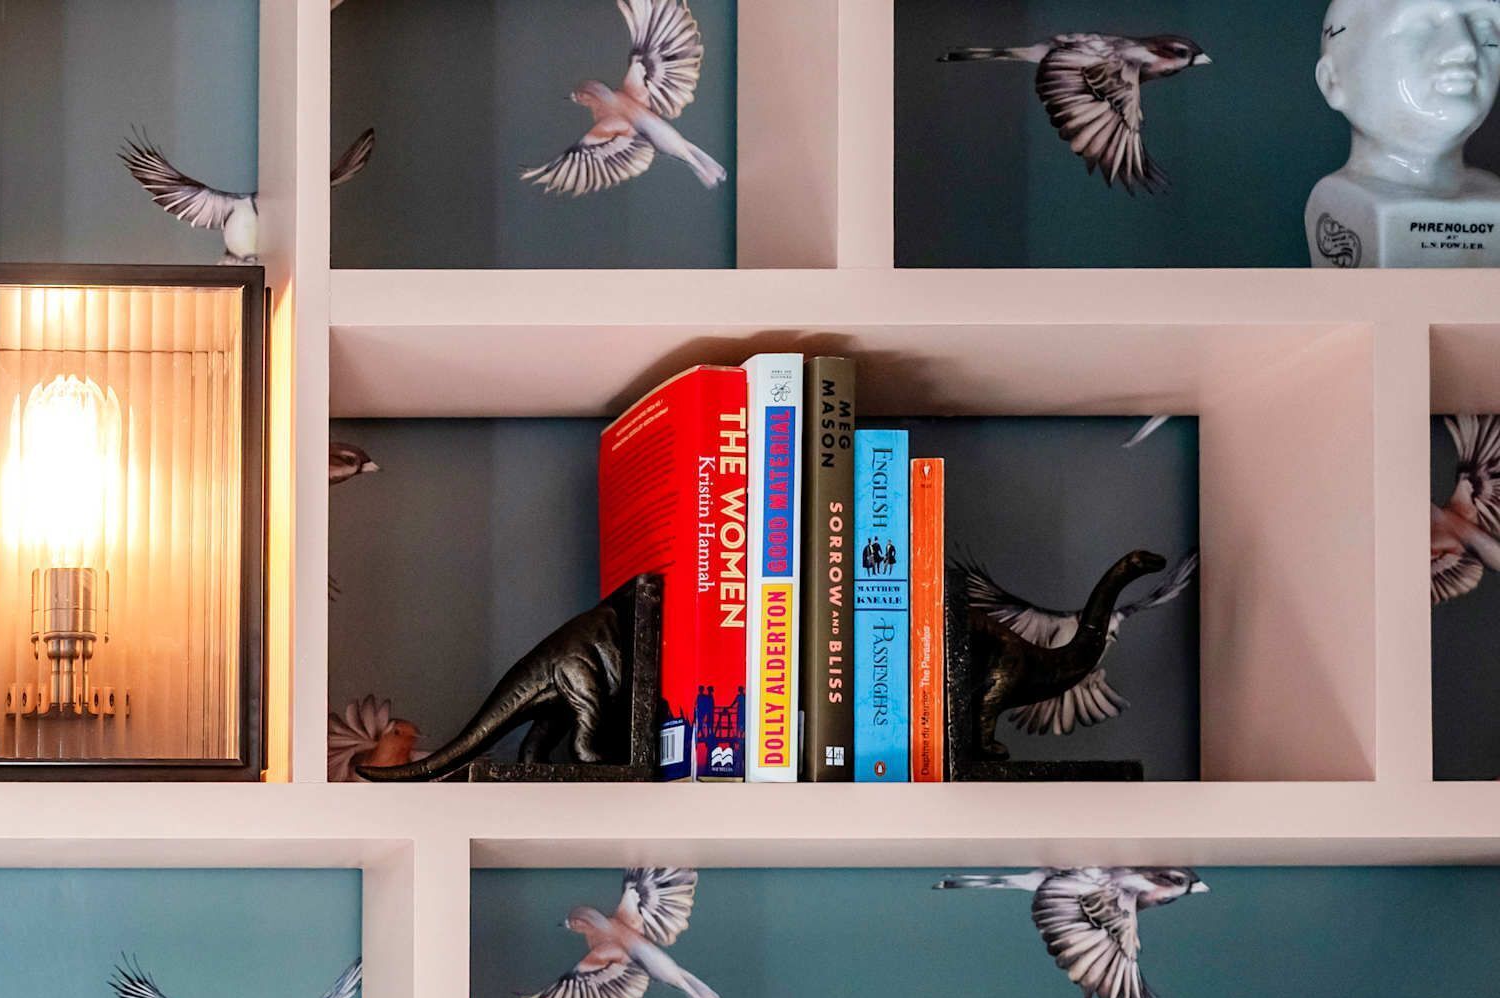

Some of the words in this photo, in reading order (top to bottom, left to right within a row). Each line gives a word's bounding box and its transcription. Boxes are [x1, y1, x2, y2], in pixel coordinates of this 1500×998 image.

[1410, 222, 1494, 234] PHRENOLOGY
[719, 407, 746, 475] THE
[821, 379, 835, 468] MASON
[838, 400, 852, 450] MEG
[698, 455, 715, 518] Kristin
[769, 409, 790, 510] MATERIAL
[871, 447, 894, 528] ENGLISH
[698, 522, 715, 593] Hannah
[719, 487, 746, 629] WOMEN
[767, 516, 788, 573] GOOD
[828, 501, 844, 607] SORROW
[831, 610, 840, 635] AND
[857, 596, 902, 604] KNEALE
[766, 591, 787, 696] ALDERTON
[828, 640, 843, 704] BLISS
[872, 617, 896, 726] PASSENGERS
[919, 669, 931, 688] The
[764, 702, 785, 765] DOLLY
[920, 740, 932, 776] Daphne
